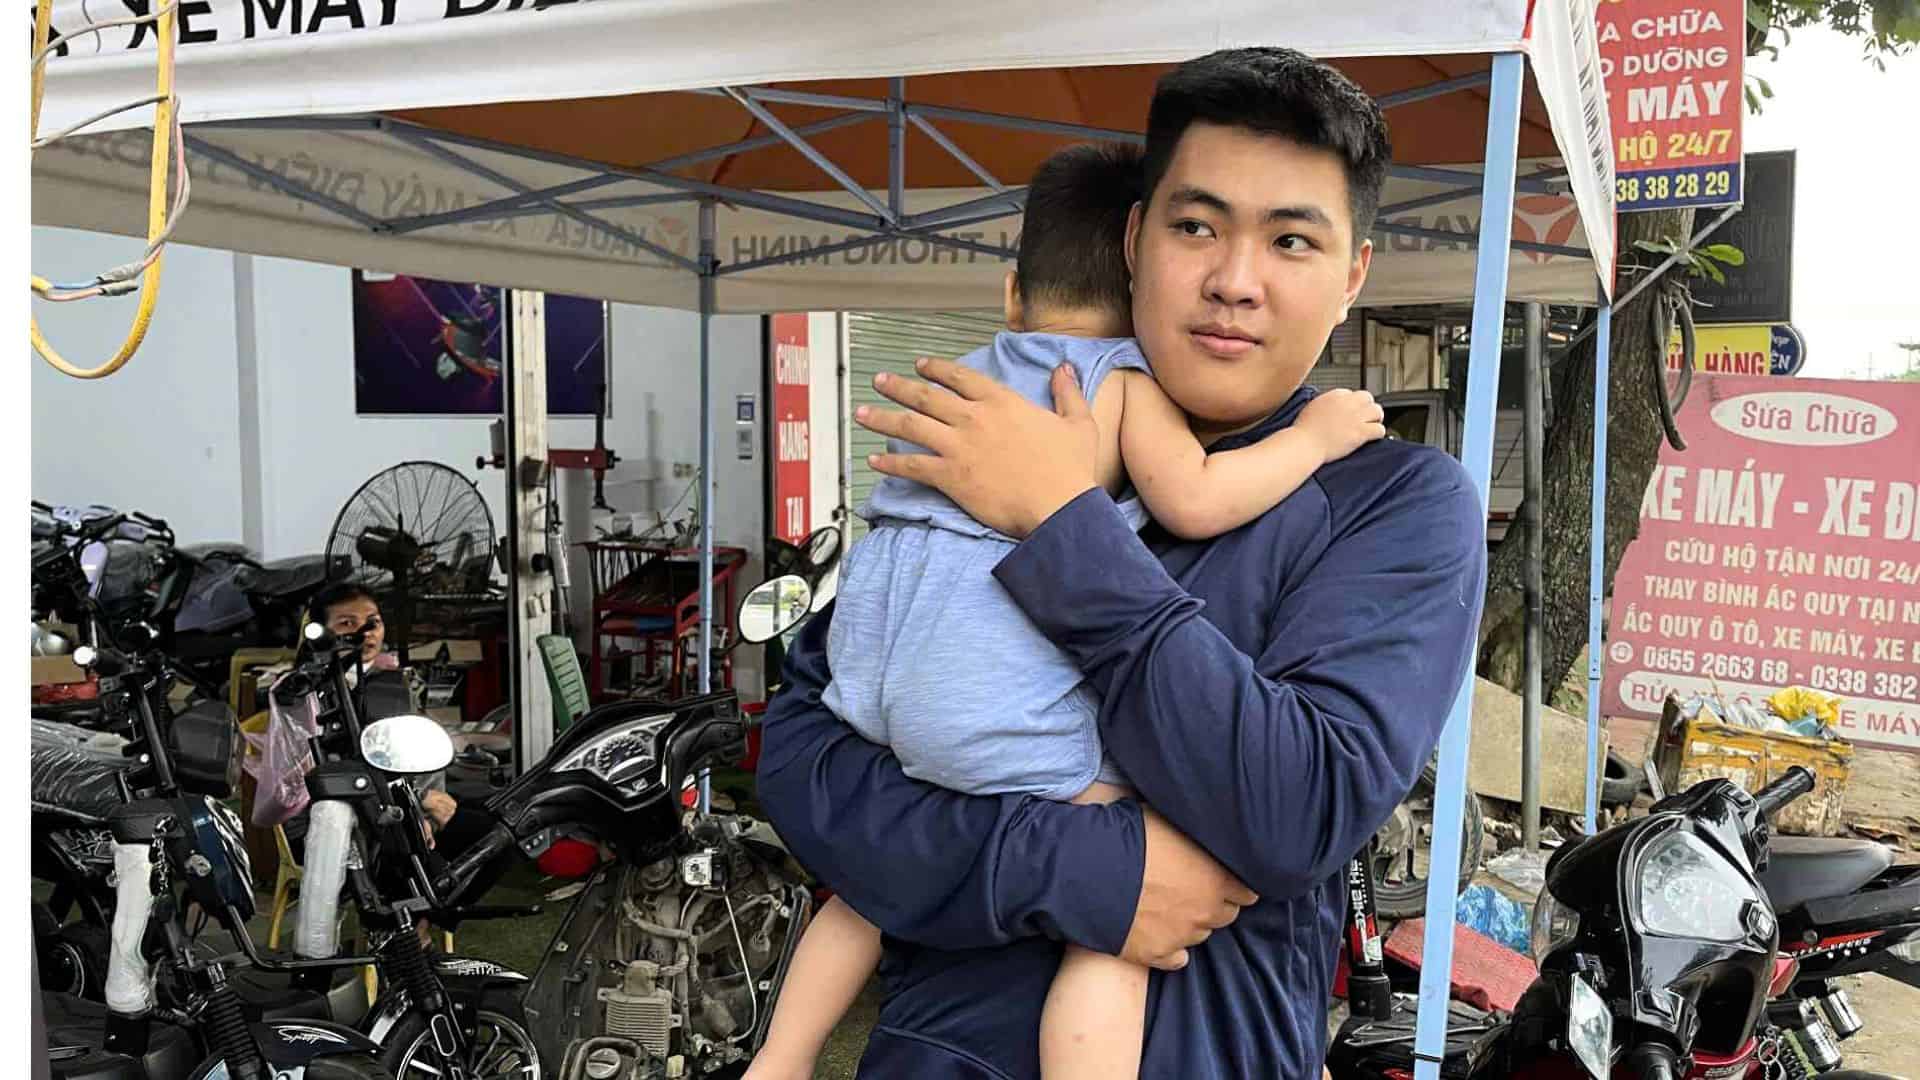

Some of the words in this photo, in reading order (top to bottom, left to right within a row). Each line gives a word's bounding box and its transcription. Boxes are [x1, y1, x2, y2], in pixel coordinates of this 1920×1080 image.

[1631, 9, 1723, 39] CHỮA
[1623, 46, 1729, 76] DƯỠNG
[1628, 76, 1729, 123] MÁY
[1619, 130, 1658, 165] HỘ
[1667, 129, 1733, 158] 24/7
[1645, 176, 1669, 199] 38
[1675, 174, 1699, 198] 28
[1705, 171, 1730, 196] 29
[1695, 458, 1785, 529] MÁY
[1819, 476, 1876, 538] XE
[1665, 537, 1715, 565] CỨU
[1722, 543, 1757, 574] HỘ
[1764, 546, 1816, 577] TẬN
[1824, 554, 1872, 580] NƠI
[1644, 575, 1697, 601] THAY
[1703, 578, 1759, 608] BÌNH
[1804, 591, 1851, 617] QUY
[1857, 596, 1896, 626] TẠI
[1659, 614, 1703, 639] QUY
[1709, 616, 1725, 641] Ô
[1773, 626, 1803, 649] XE
[1873, 637, 1905, 661] XE
[1643, 646, 1695, 673] 0855
[1701, 652, 1754, 680] 2663
[1760, 658, 1789, 684] 68
[1811, 664, 1867, 694] 0338
[1873, 671, 1918, 700] 382
